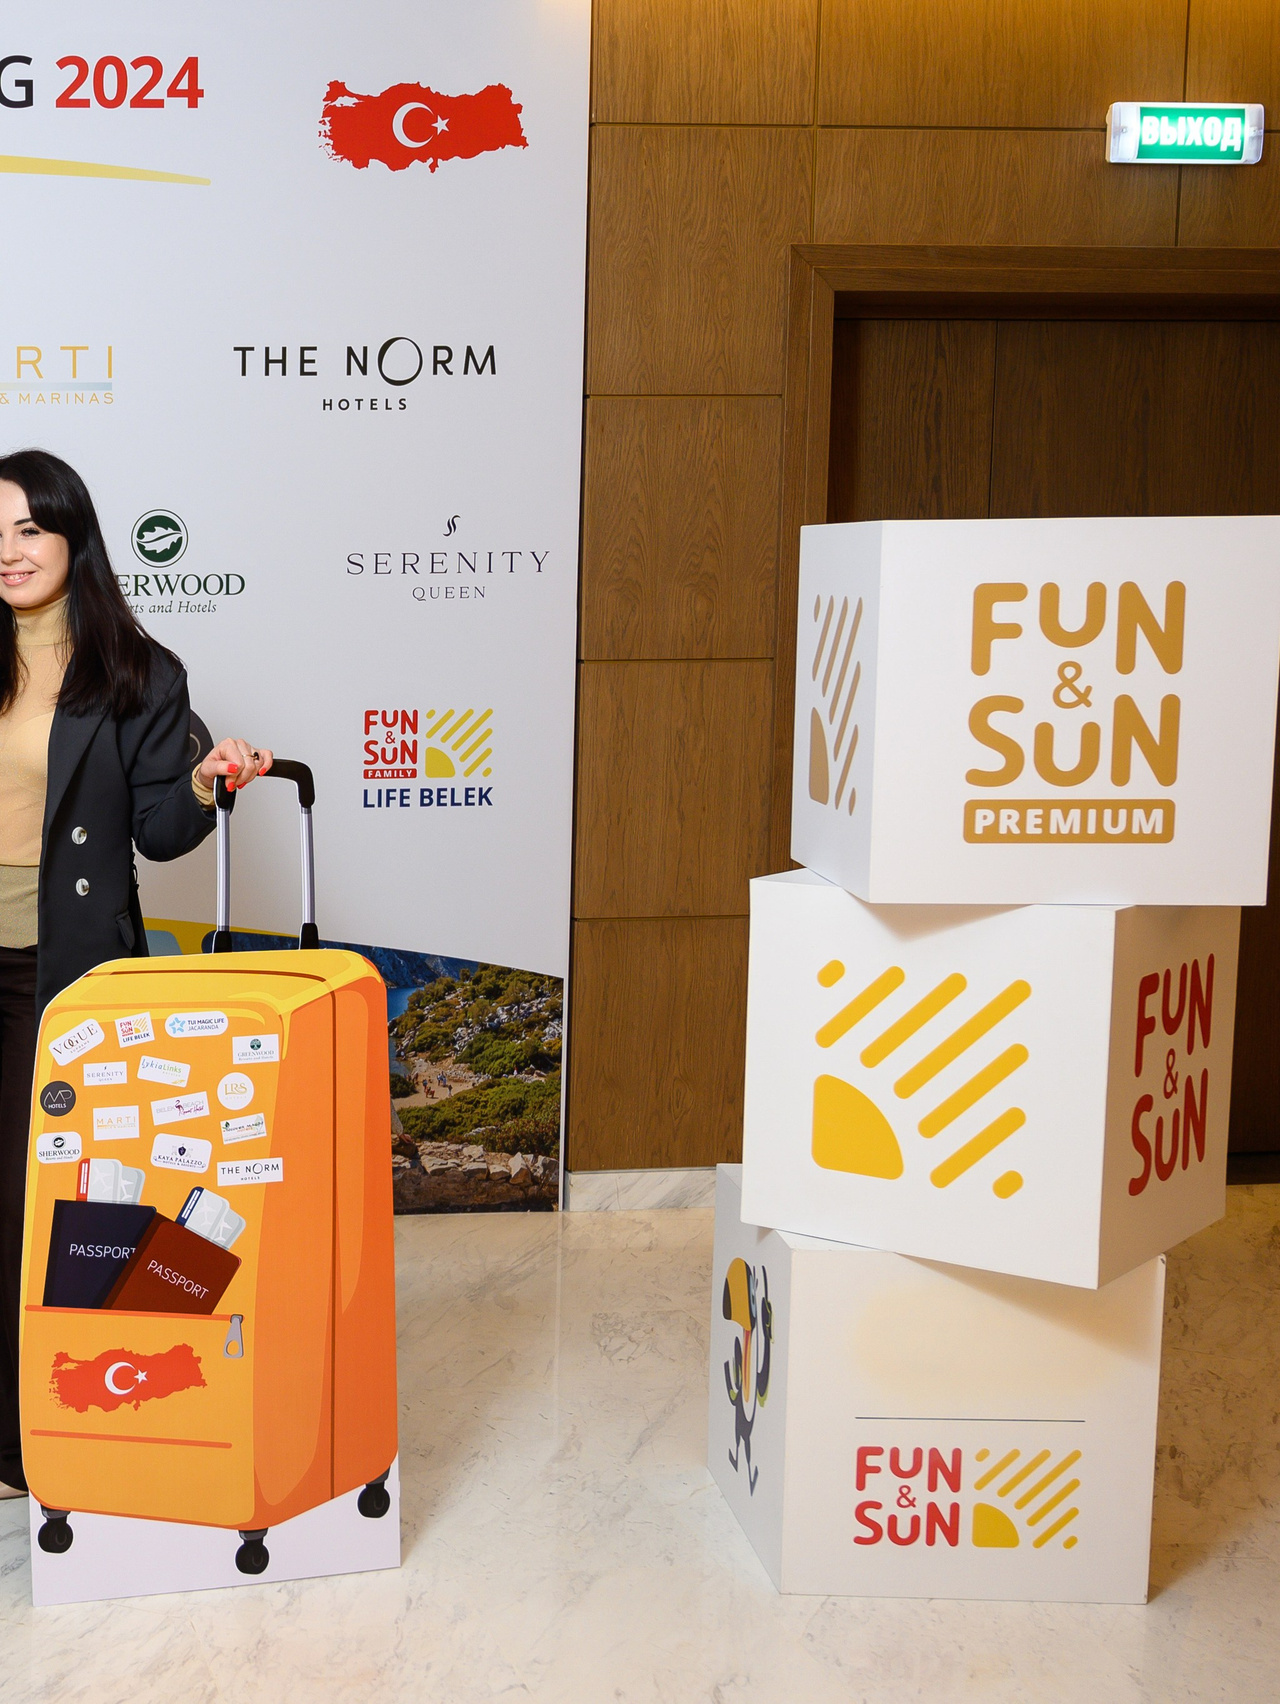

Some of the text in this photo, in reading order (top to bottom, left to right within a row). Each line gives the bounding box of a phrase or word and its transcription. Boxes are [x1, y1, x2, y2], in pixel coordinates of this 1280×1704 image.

[55, 55, 205, 109] 2024
[1142, 116, 1242, 151] ВЫХОД
[234, 337, 497, 386] THE NORM
[0, 392, 11, 405] &
[18, 391, 114, 405] MARINAS
[323, 398, 407, 411] HOTELS
[347, 550, 550, 575] SERENITY
[115, 574, 245, 596] ERWOOD
[412, 586, 487, 602] QUEEN
[149, 601, 172, 613] and
[177, 600, 217, 613] Hotels
[971, 581, 1186, 676] FUN
[1053, 661, 1092, 709] &
[364, 709, 419, 736] FUN
[385, 730, 396, 745] &
[965, 694, 1181, 787] SUN
[364, 739, 418, 765] SUN
[367, 770, 415, 778] FAMILY
[363, 786, 493, 808] LIFE BELEK
[974, 809, 1164, 834] PREMIUM
[1134, 953, 1215, 1077] FUN
[52, 1023, 98, 1055] VOGUE
[134, 1032, 150, 1041] BELEK
[86, 1070, 124, 1078] SERENITY
[1163, 1048, 1179, 1099] &
[224, 1082, 248, 1095] LRS
[96, 1116, 136, 1125] MARTI
[1128, 1068, 1208, 1196] SUN
[39, 1149, 80, 1157] SHERWOOD
[221, 1162, 280, 1174] THE NORM
[146, 1260, 210, 1300] PASSPORT
[855, 1446, 962, 1493] FUN
[896, 1485, 917, 1509] &
[853, 1500, 960, 1547] SUN
